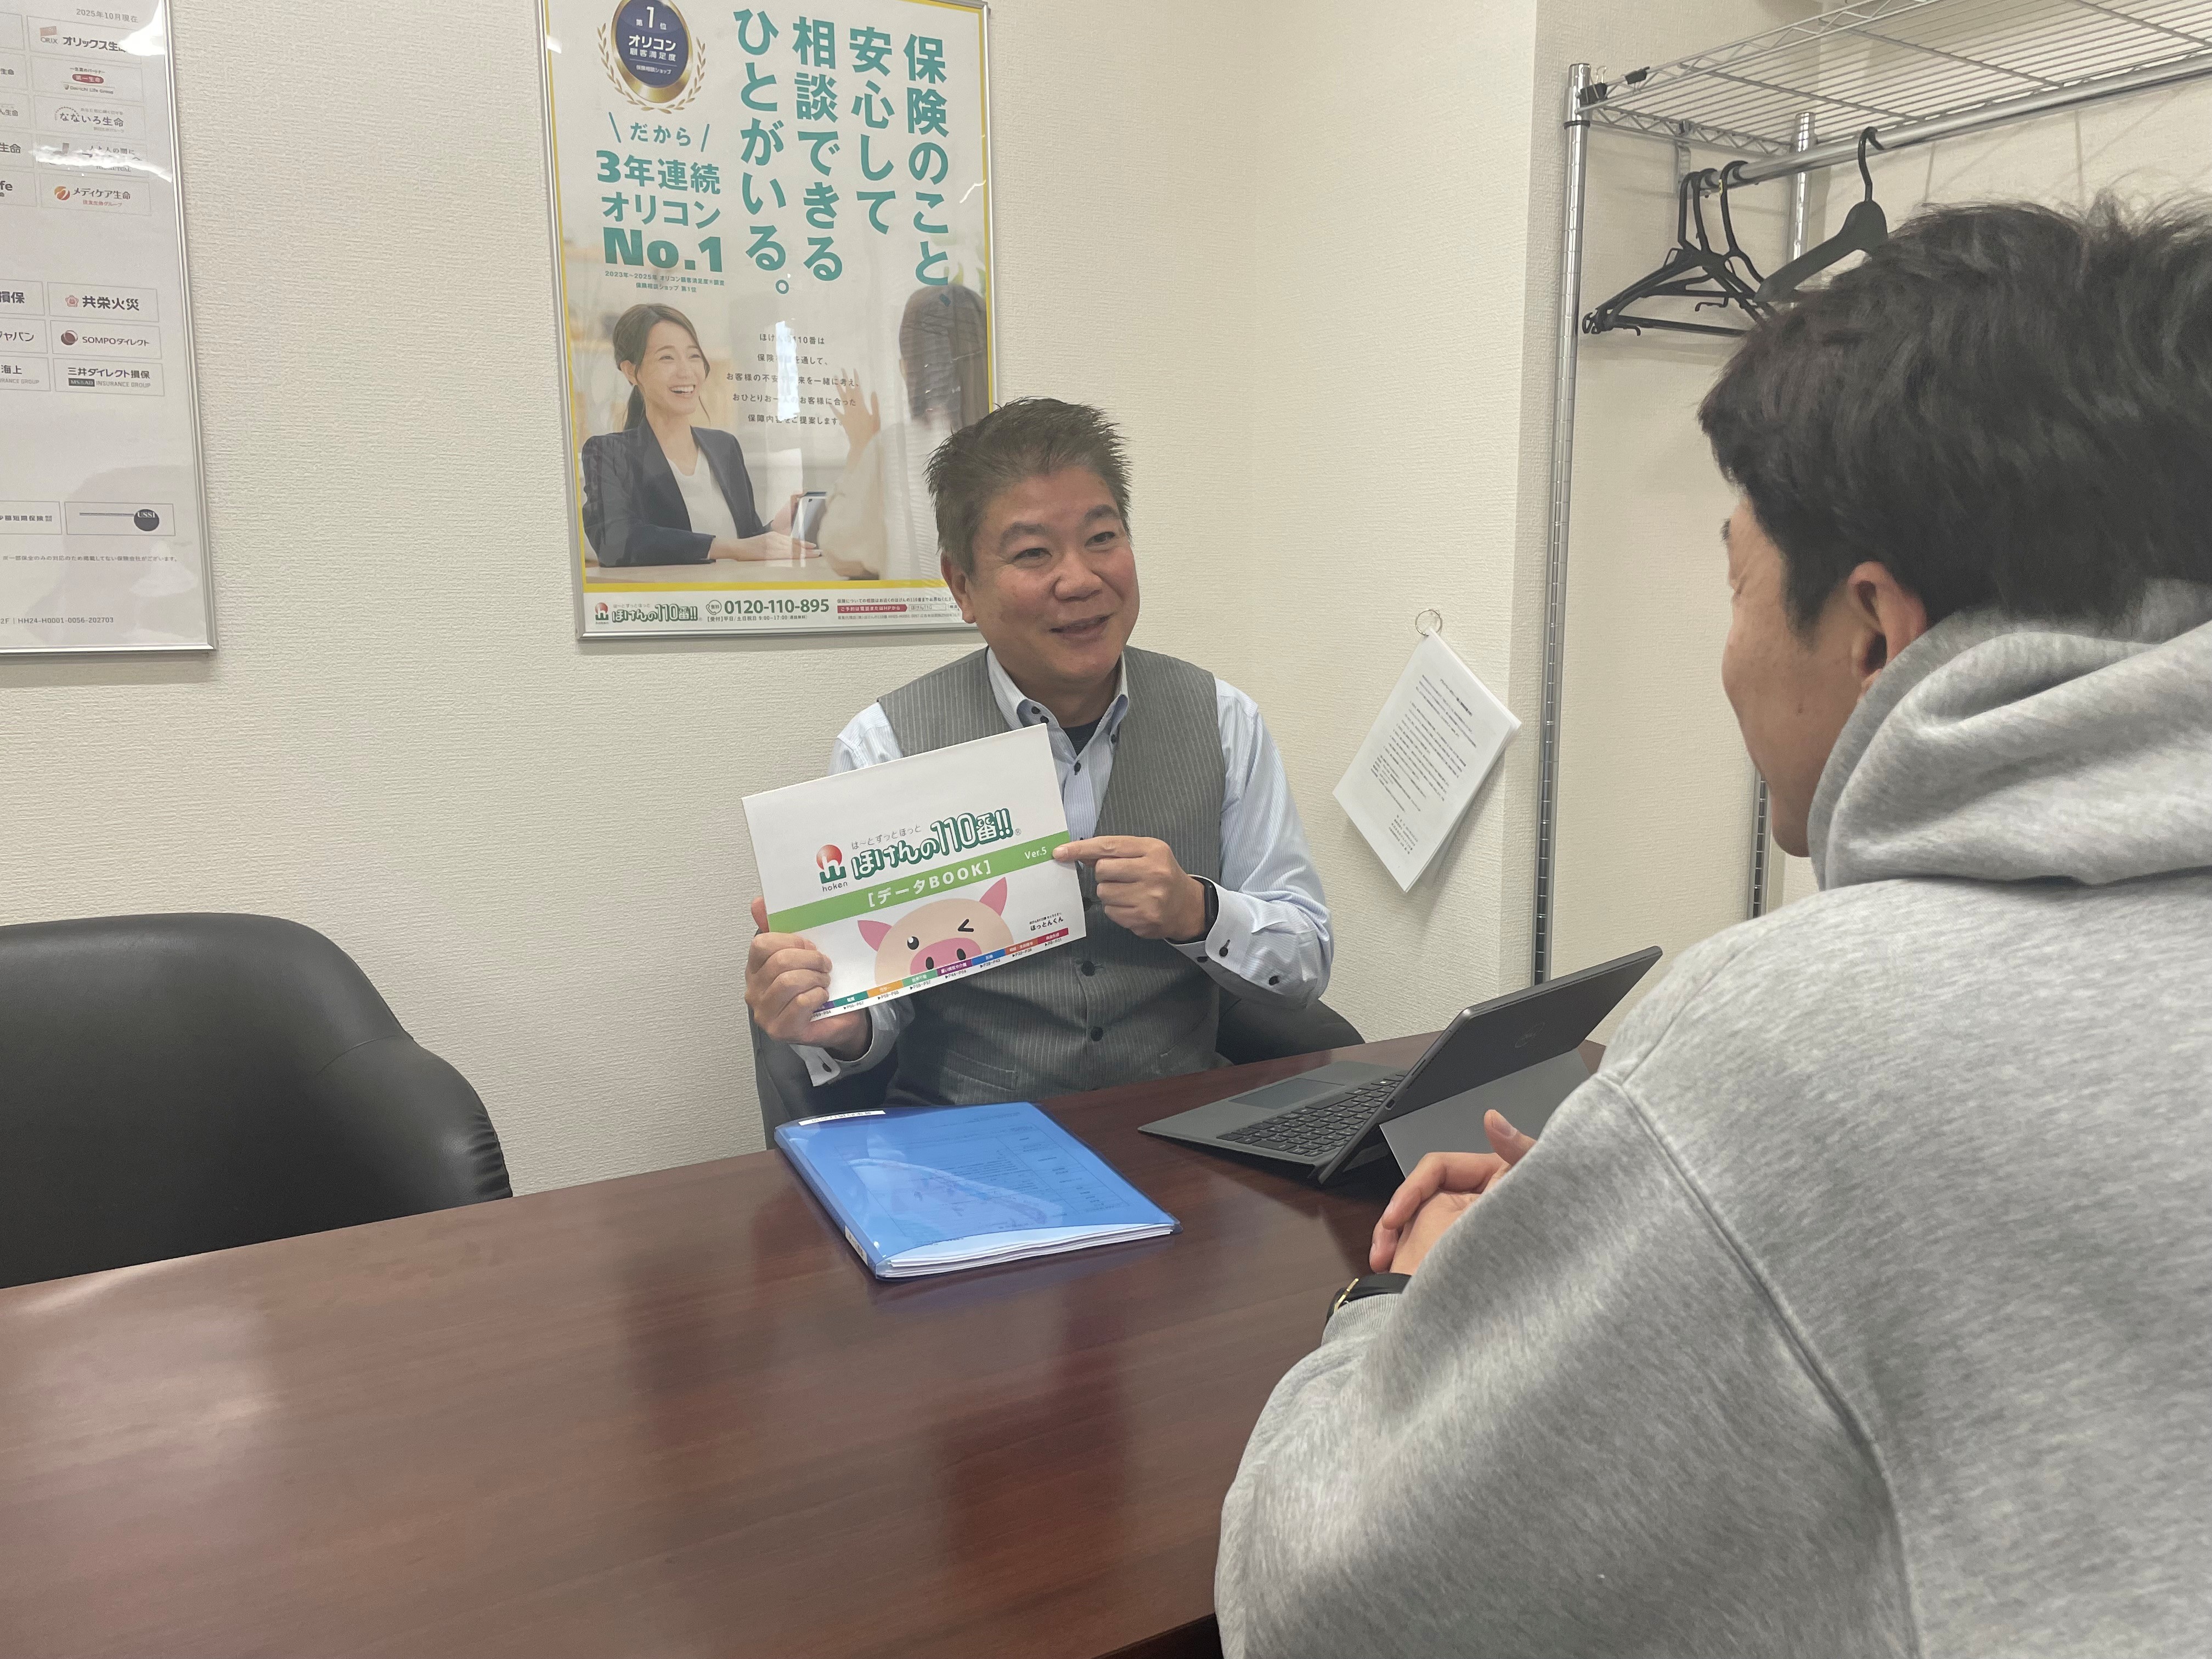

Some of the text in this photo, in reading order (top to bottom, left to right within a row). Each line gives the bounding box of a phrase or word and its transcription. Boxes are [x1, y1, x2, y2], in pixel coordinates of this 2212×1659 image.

[76, 8, 138, 23] 2025年10月現在
[63, 36, 126, 53] オリックス生
[628, 35, 676, 51] オリコン
[60, 112, 124, 127] なないろ生命
[630, 122, 692, 146] だから
[849, 26, 895, 235] 安心して
[733, 8, 789, 295] ひとがいる。
[792, 15, 843, 281] 相談できる
[596, 150, 721, 195] 3年連続
[73, 187, 131, 200] メディケア生命
[601, 191, 721, 229] オリコン
[603, 227, 723, 273] No.1
[82, 296, 139, 311] 共栄火災
[82, 336, 150, 346] SOMPOダイレクト
[757, 353, 827, 365] 保険を通して、
[68, 367, 150, 379] 三井ダイレクト損保
[726, 373, 859, 387] お客様の不安来を一緒に考え、
[724, 598, 830, 614] 0120-110-895
[1024, 846, 1047, 860] Ver.5
[822, 881, 848, 893] hoken
[1030, 916, 1064, 931] ほっとんくん
